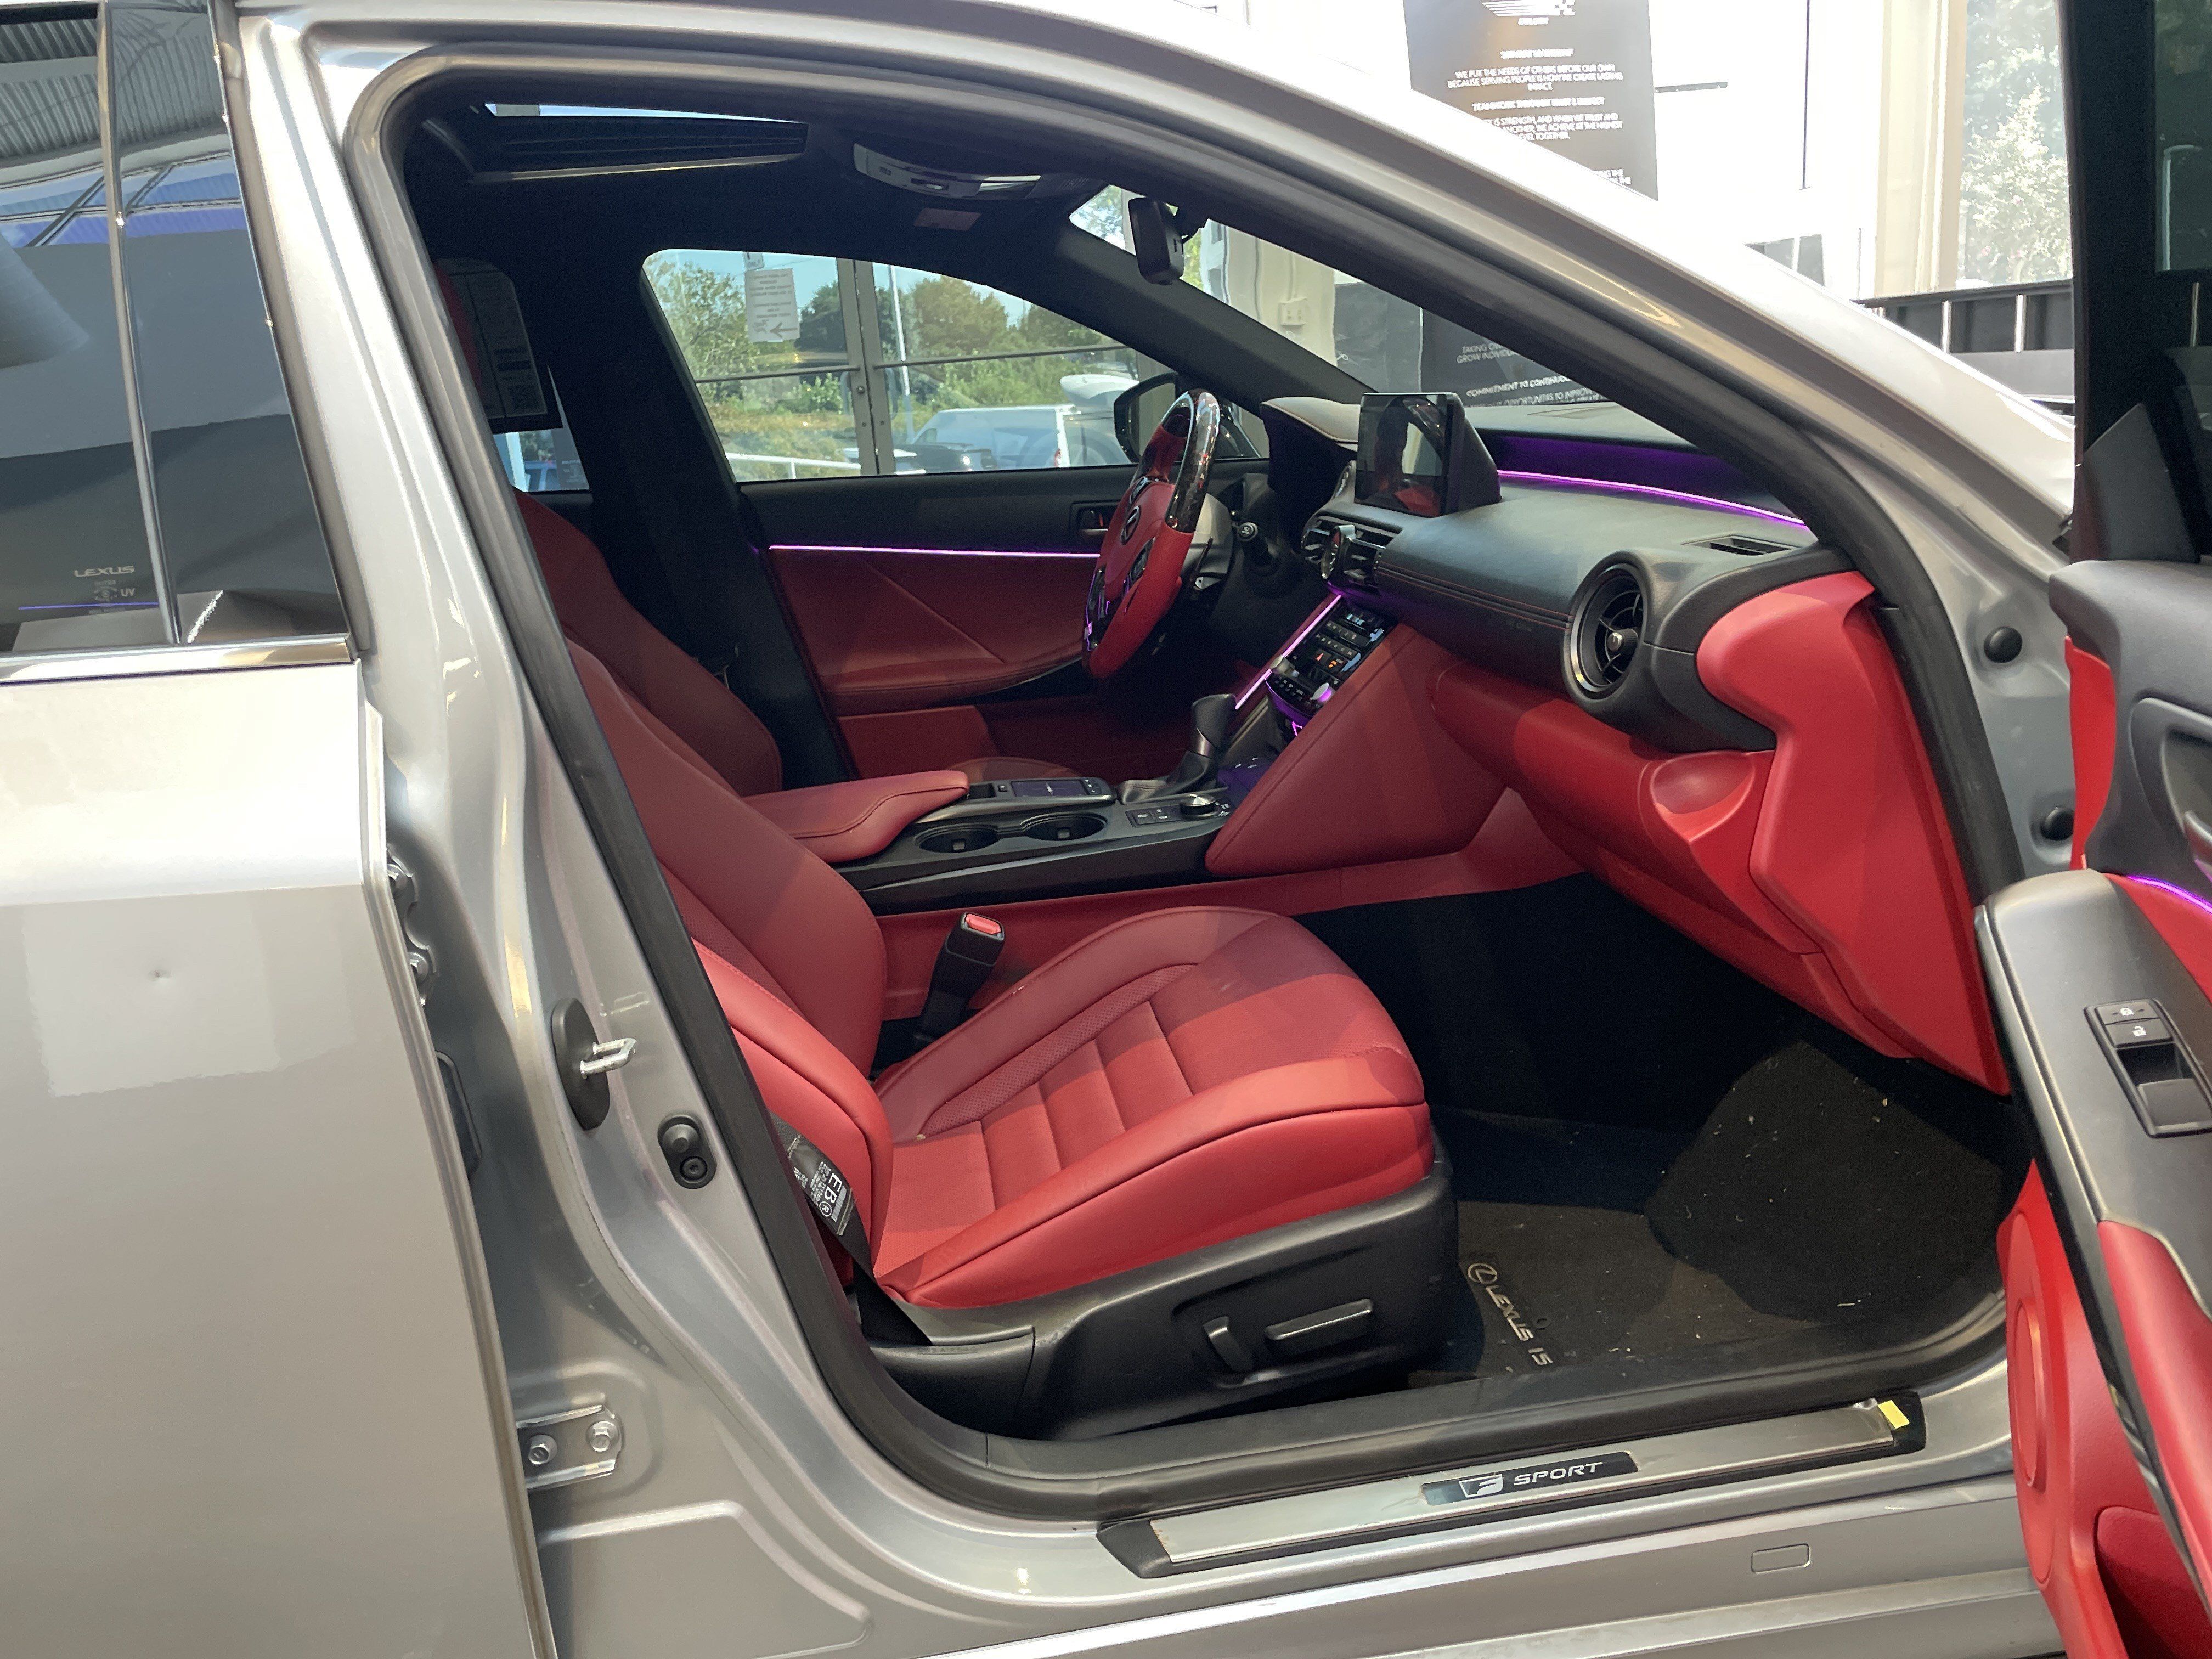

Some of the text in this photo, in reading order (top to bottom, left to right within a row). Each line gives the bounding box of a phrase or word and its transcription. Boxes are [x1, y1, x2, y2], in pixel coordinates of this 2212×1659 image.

[1455, 70, 1468, 78] WE
[1469, 69, 1482, 78] PUT
[1497, 66, 1520, 76] NEEDS
[1520, 66, 1531, 75] OF
[1582, 64, 1597, 72] OUR
[1447, 78, 1480, 88] BECAUSE
[1480, 76, 1511, 86] SERVING
[1511, 75, 1536, 83] PEOPLE
[1472, 101, 1516, 111] TEAMWORK
[1537, 115, 1552, 123] AND
[1457, 353, 1481, 363] GROW
[1466, 382, 1518, 397] COMMITMENT
[1519, 380, 1528, 388] TO
[74, 565, 135, 578] LEXUS
[121, 587, 135, 597] UV
[1485, 1285, 1554, 1365] LEXUS IS
[1513, 1461, 1603, 1486] SPORT
